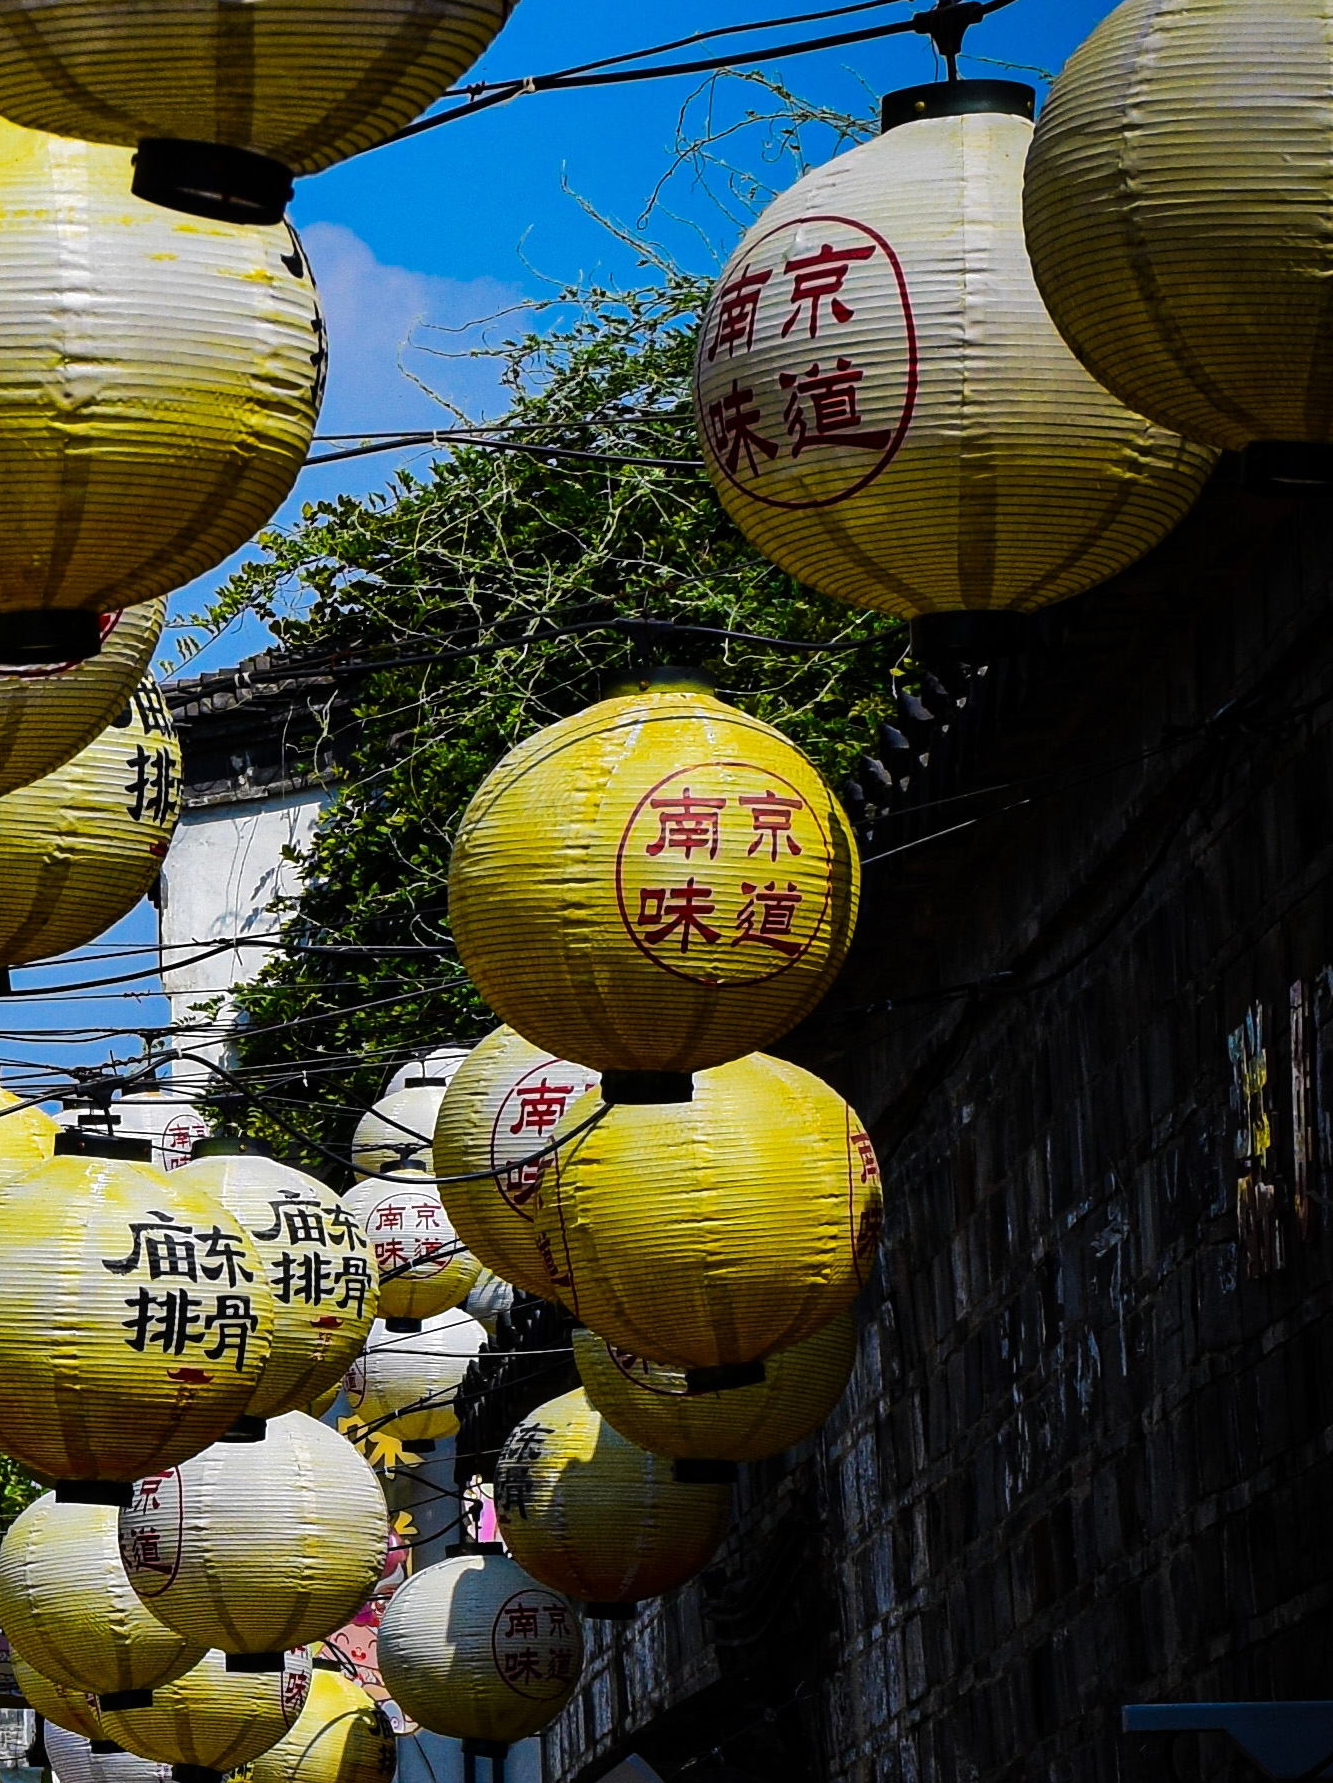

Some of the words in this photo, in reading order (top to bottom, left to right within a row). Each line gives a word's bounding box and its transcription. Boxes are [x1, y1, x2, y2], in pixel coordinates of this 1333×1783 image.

[708, 244, 877, 361] 南京
[708, 357, 891, 477] 味道
[646, 788, 803, 861] 南京
[636, 879, 806, 958] 味道
[510, 1078, 596, 1137] 南
[249, 1189, 368, 1250] 庙东
[375, 1203, 442, 1231] 南京
[104, 1211, 256, 1288] 庙东
[373, 1235, 447, 1267] 味道
[270, 1251, 372, 1318] 排骨
[122, 1288, 259, 1372] 排骨
[121, 1526, 174, 1576] 道
[505, 1603, 572, 1640] 南京
[504, 1649, 574, 1686] 味道
